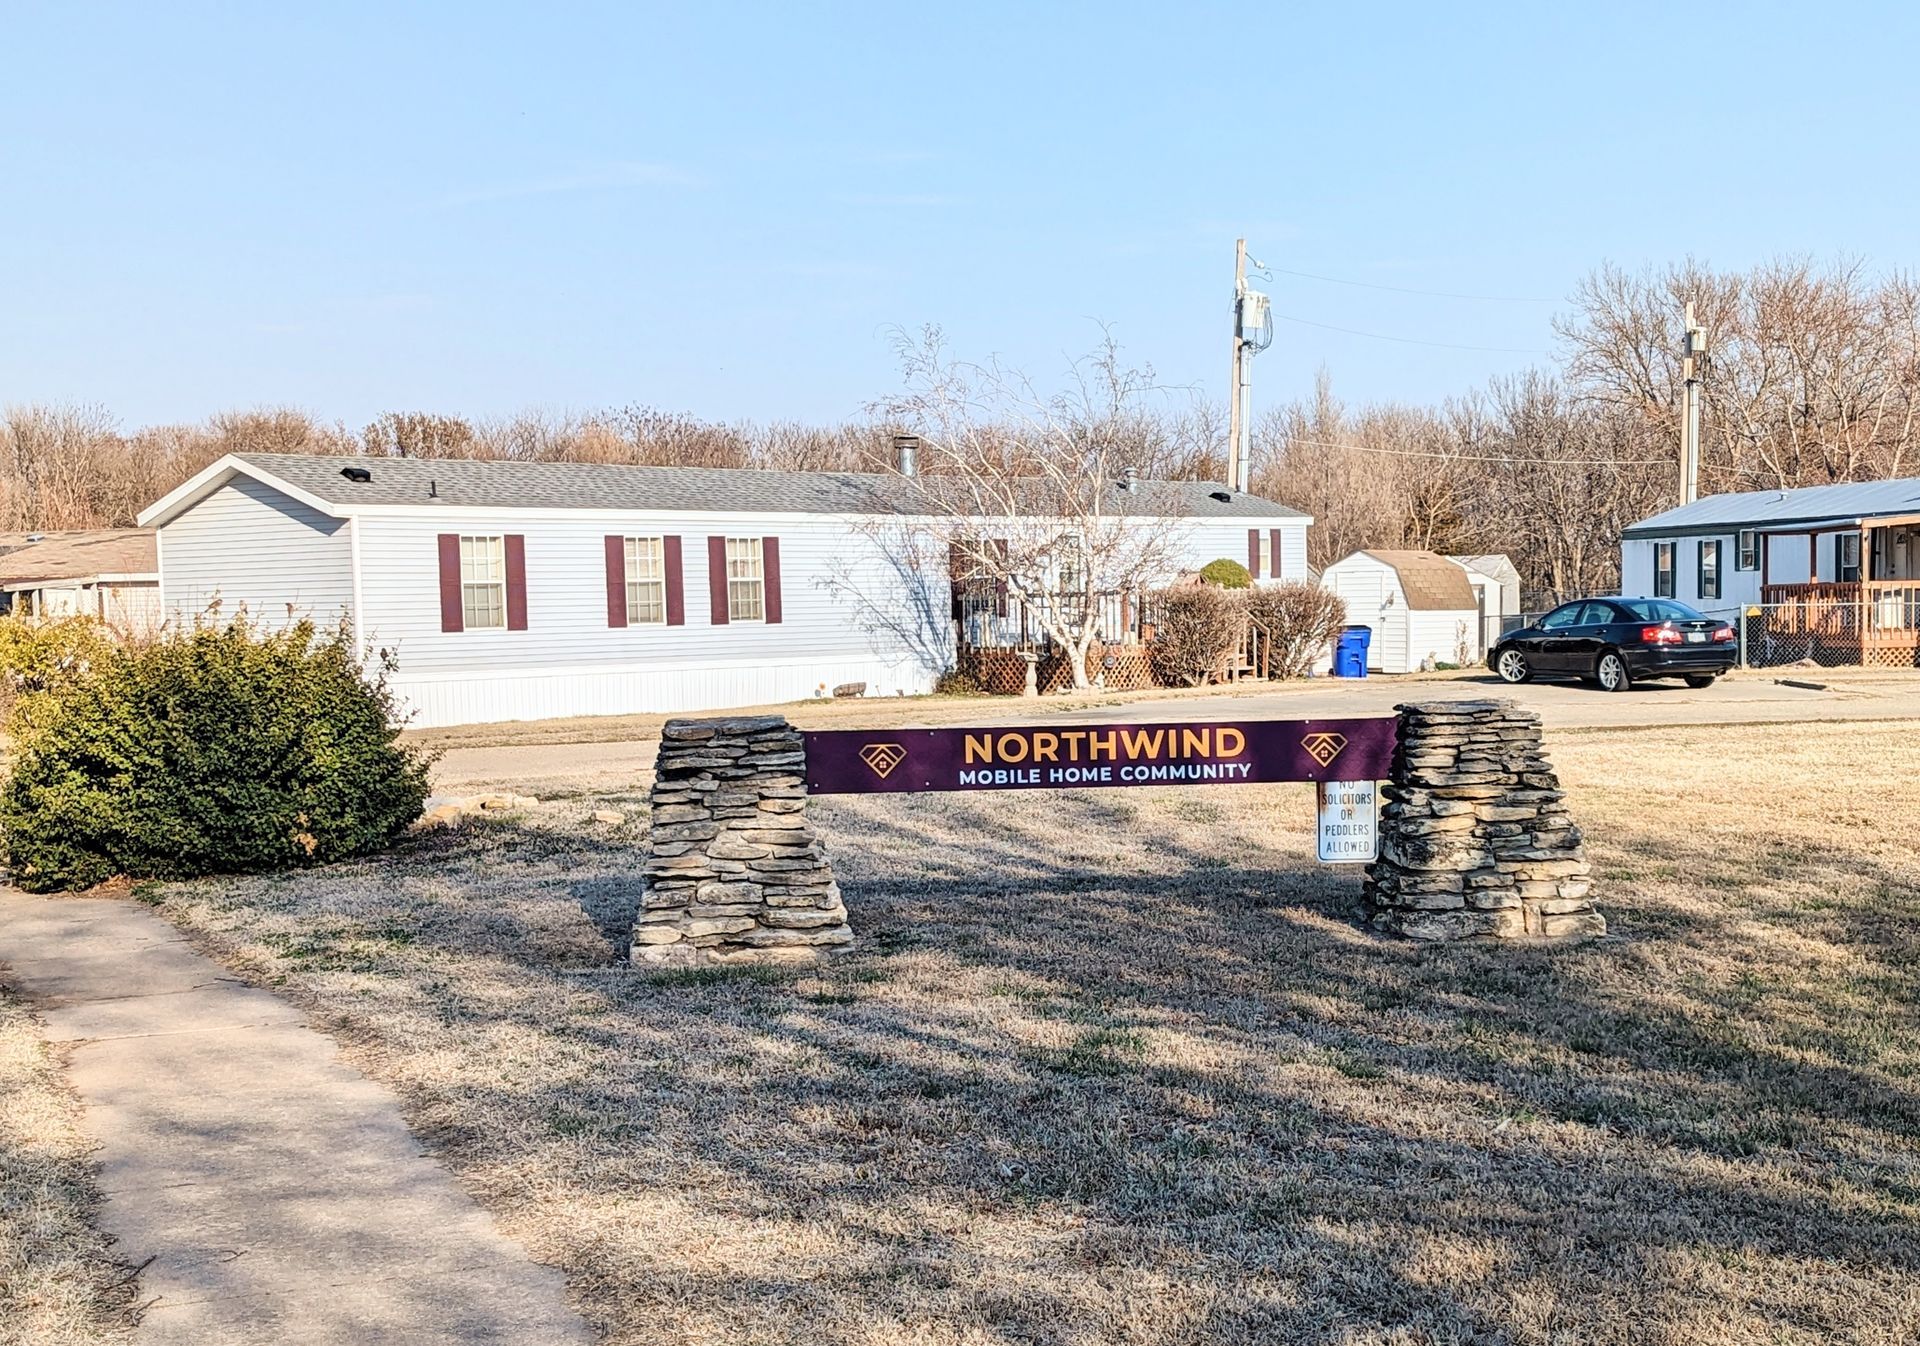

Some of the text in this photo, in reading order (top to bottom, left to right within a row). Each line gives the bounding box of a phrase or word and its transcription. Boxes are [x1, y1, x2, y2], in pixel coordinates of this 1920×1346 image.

[965, 728, 1246, 764] NORTHWIND
[959, 763, 1252, 785] MOBILE HOME COMMUNITY
[1340, 781, 1354, 790] NO
[1322, 793, 1372, 805] SOLICITORS
[1340, 809, 1353, 820] OR
[1325, 824, 1369, 836] PEDDLERS
[1326, 841, 1369, 853] ALLOWED
